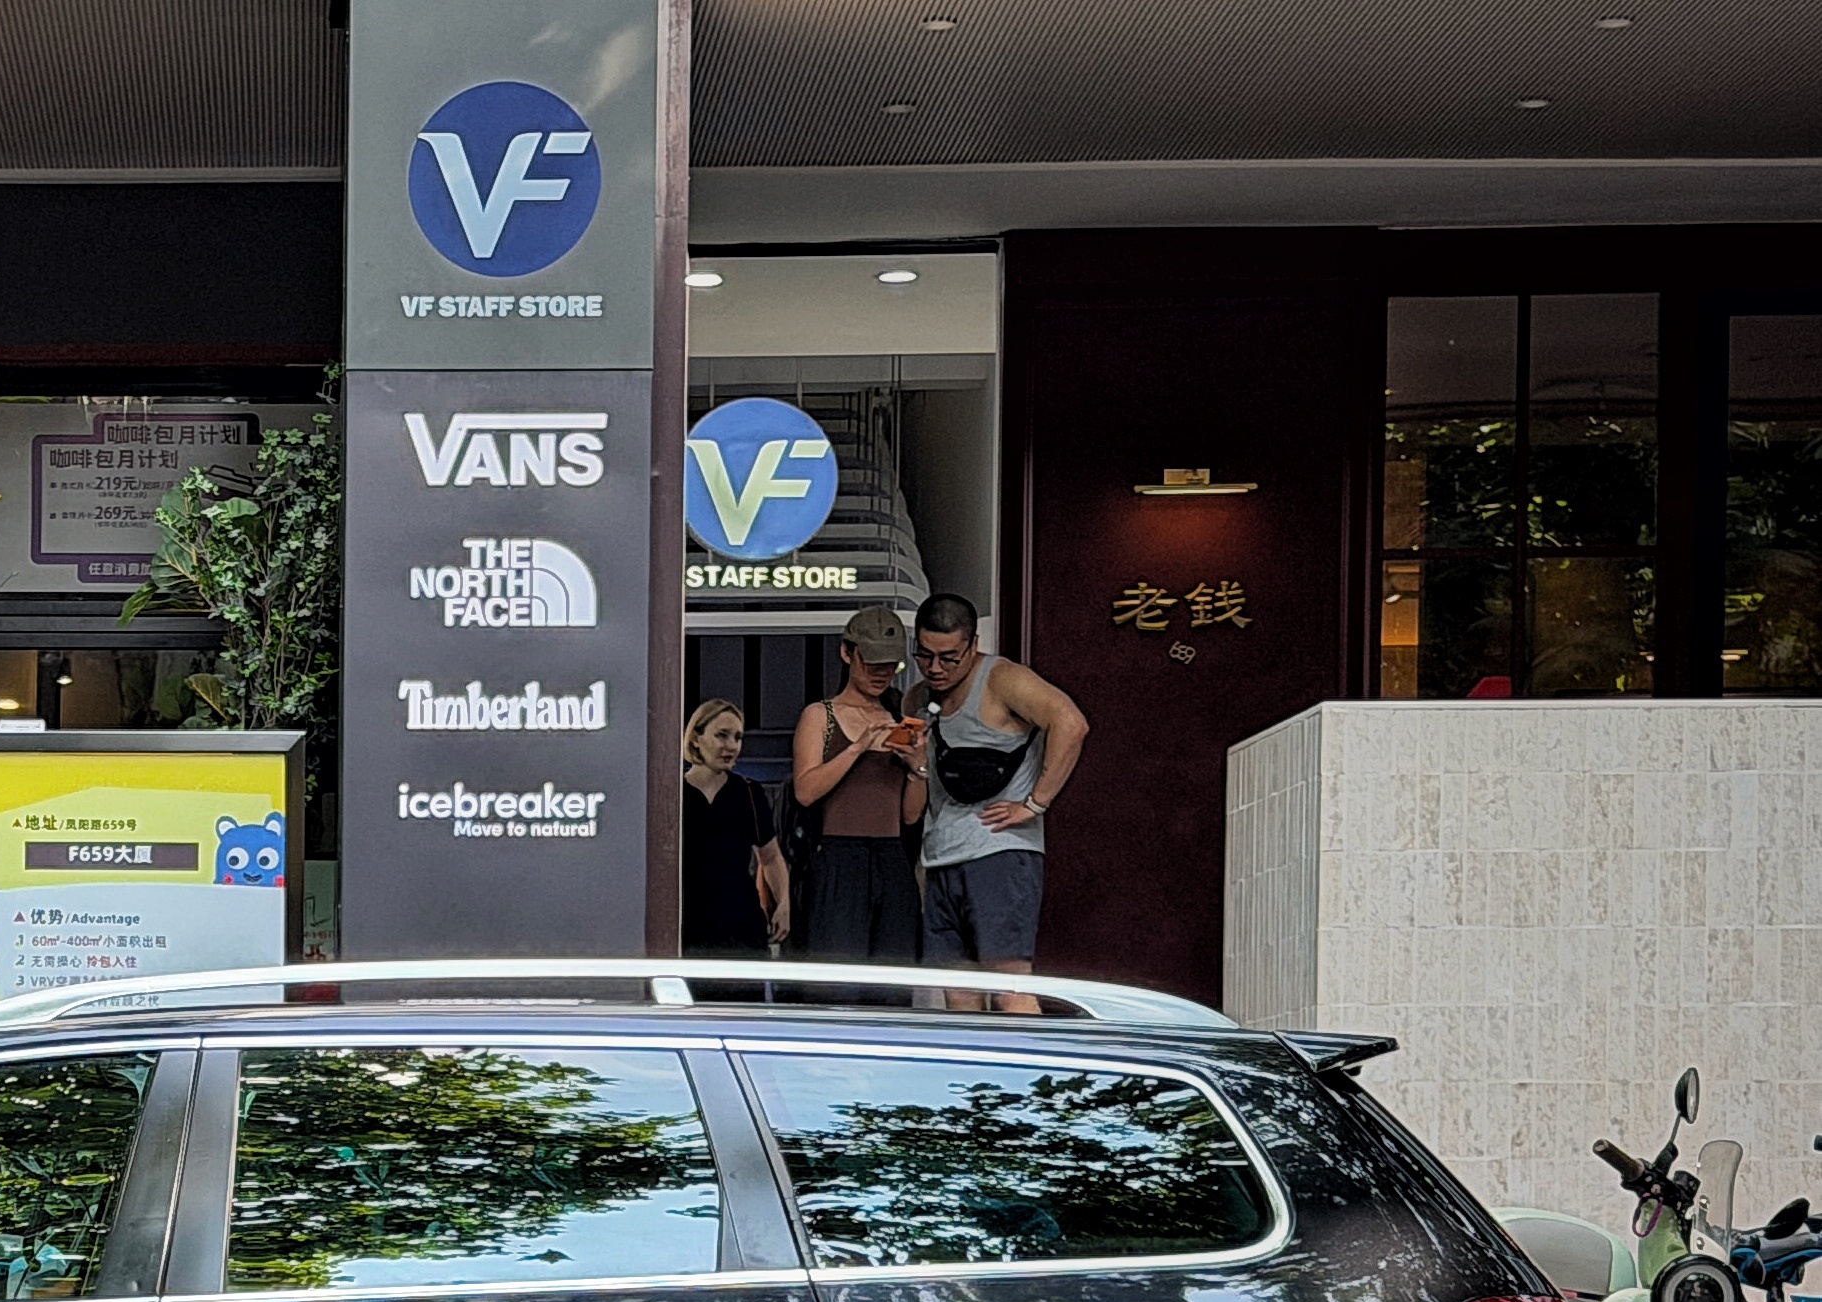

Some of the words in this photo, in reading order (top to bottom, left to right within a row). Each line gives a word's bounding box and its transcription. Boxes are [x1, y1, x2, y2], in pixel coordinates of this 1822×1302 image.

[416, 131, 592, 259] VF
[401, 295, 436, 318] VF
[438, 295, 515, 318] STAFF
[519, 295, 603, 318] STORE
[107, 424, 242, 445] 咖啡包月计划
[49, 449, 178, 469] 咖啡包月计划
[404, 412, 608, 487] VANS
[685, 439, 830, 546] VF
[462, 538, 531, 569] THE
[409, 568, 532, 599] NORTH
[685, 565, 769, 589] STAFF
[772, 565, 858, 589] STORE
[444, 597, 532, 626] FACE
[397, 680, 606, 732] Timberland
[398, 782, 606, 820] icebreaker
[454, 820, 503, 838] Move
[507, 820, 526, 838] to
[529, 819, 597, 838] natural
[67, 845, 154, 864] F659大厦
[30, 908, 141, 926] 优势/Advantage
[30, 955, 82, 968] 无需操心
[86, 955, 138, 968] 拎包入住
